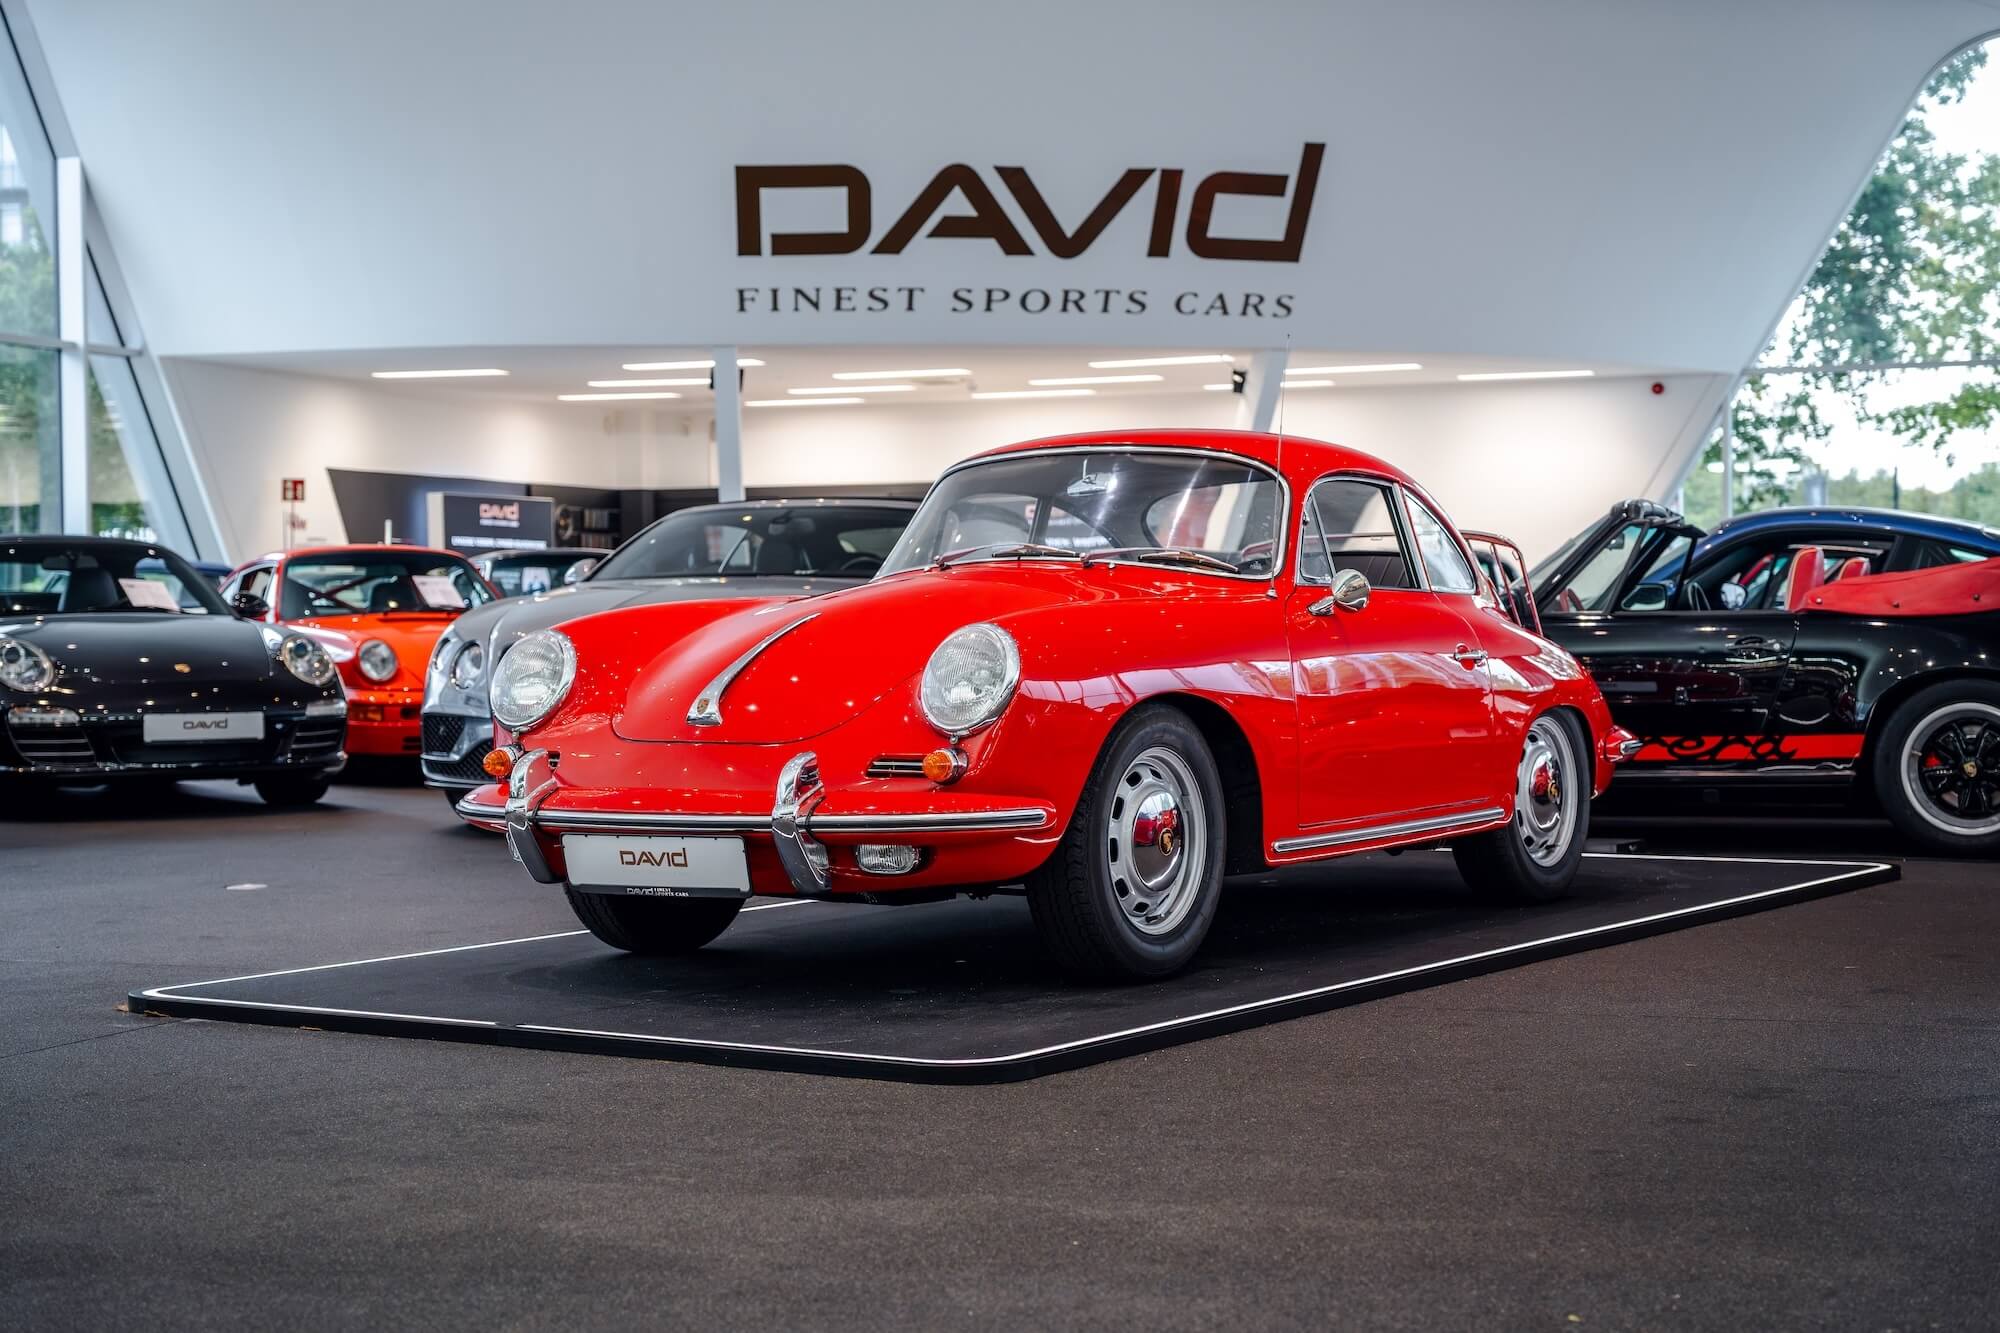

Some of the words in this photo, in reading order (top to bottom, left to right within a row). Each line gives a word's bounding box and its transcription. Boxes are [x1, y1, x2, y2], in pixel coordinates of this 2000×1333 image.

[736, 287, 924, 312] FINEST
[951, 288, 1147, 313] SPORTS
[1174, 291, 1295, 318] CARS
